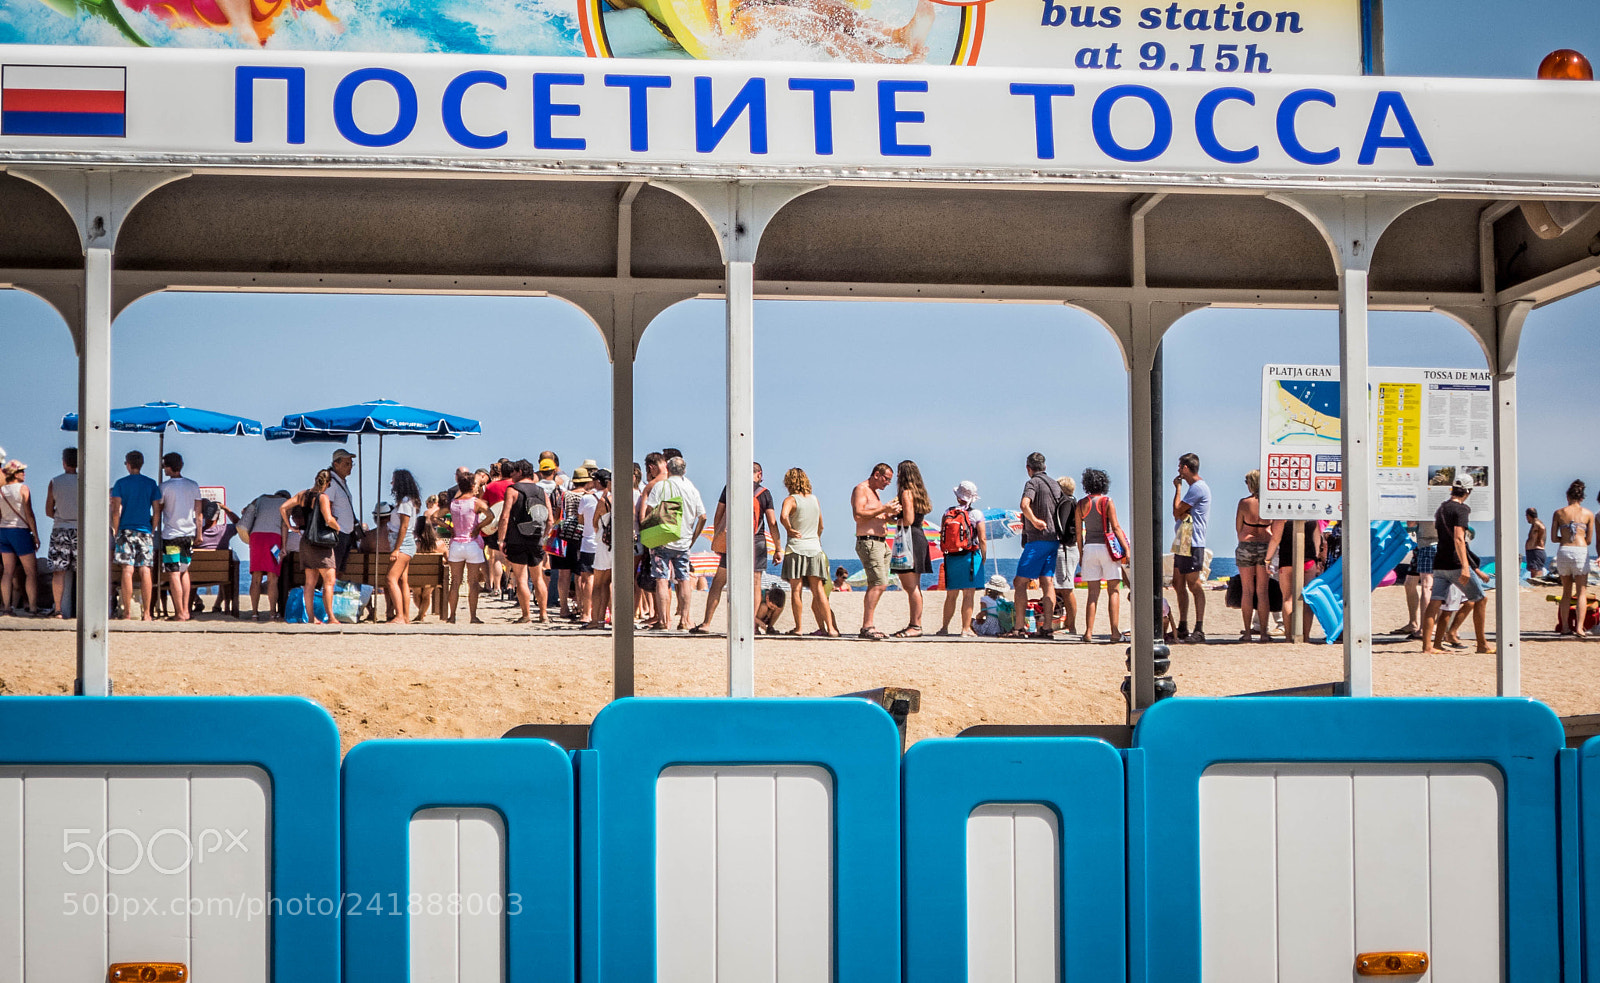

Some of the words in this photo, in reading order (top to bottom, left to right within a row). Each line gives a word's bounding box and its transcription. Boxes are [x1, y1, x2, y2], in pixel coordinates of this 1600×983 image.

[1041, 0, 1122, 28] bus
[1138, 1, 1304, 33] station
[1074, 42, 1123, 69] at
[1138, 41, 1273, 73] 9.15h
[234, 65, 932, 157] ПОСЕТИТЕ
[1009, 82, 1435, 166] ТОССА
[1269, 366, 1303, 378] PLATJA
[1305, 367, 1333, 377] GRAN
[1423, 370, 1453, 380] TOSSA
[1455, 371, 1468, 380] DE
[1470, 372, 1491, 381] MAR
